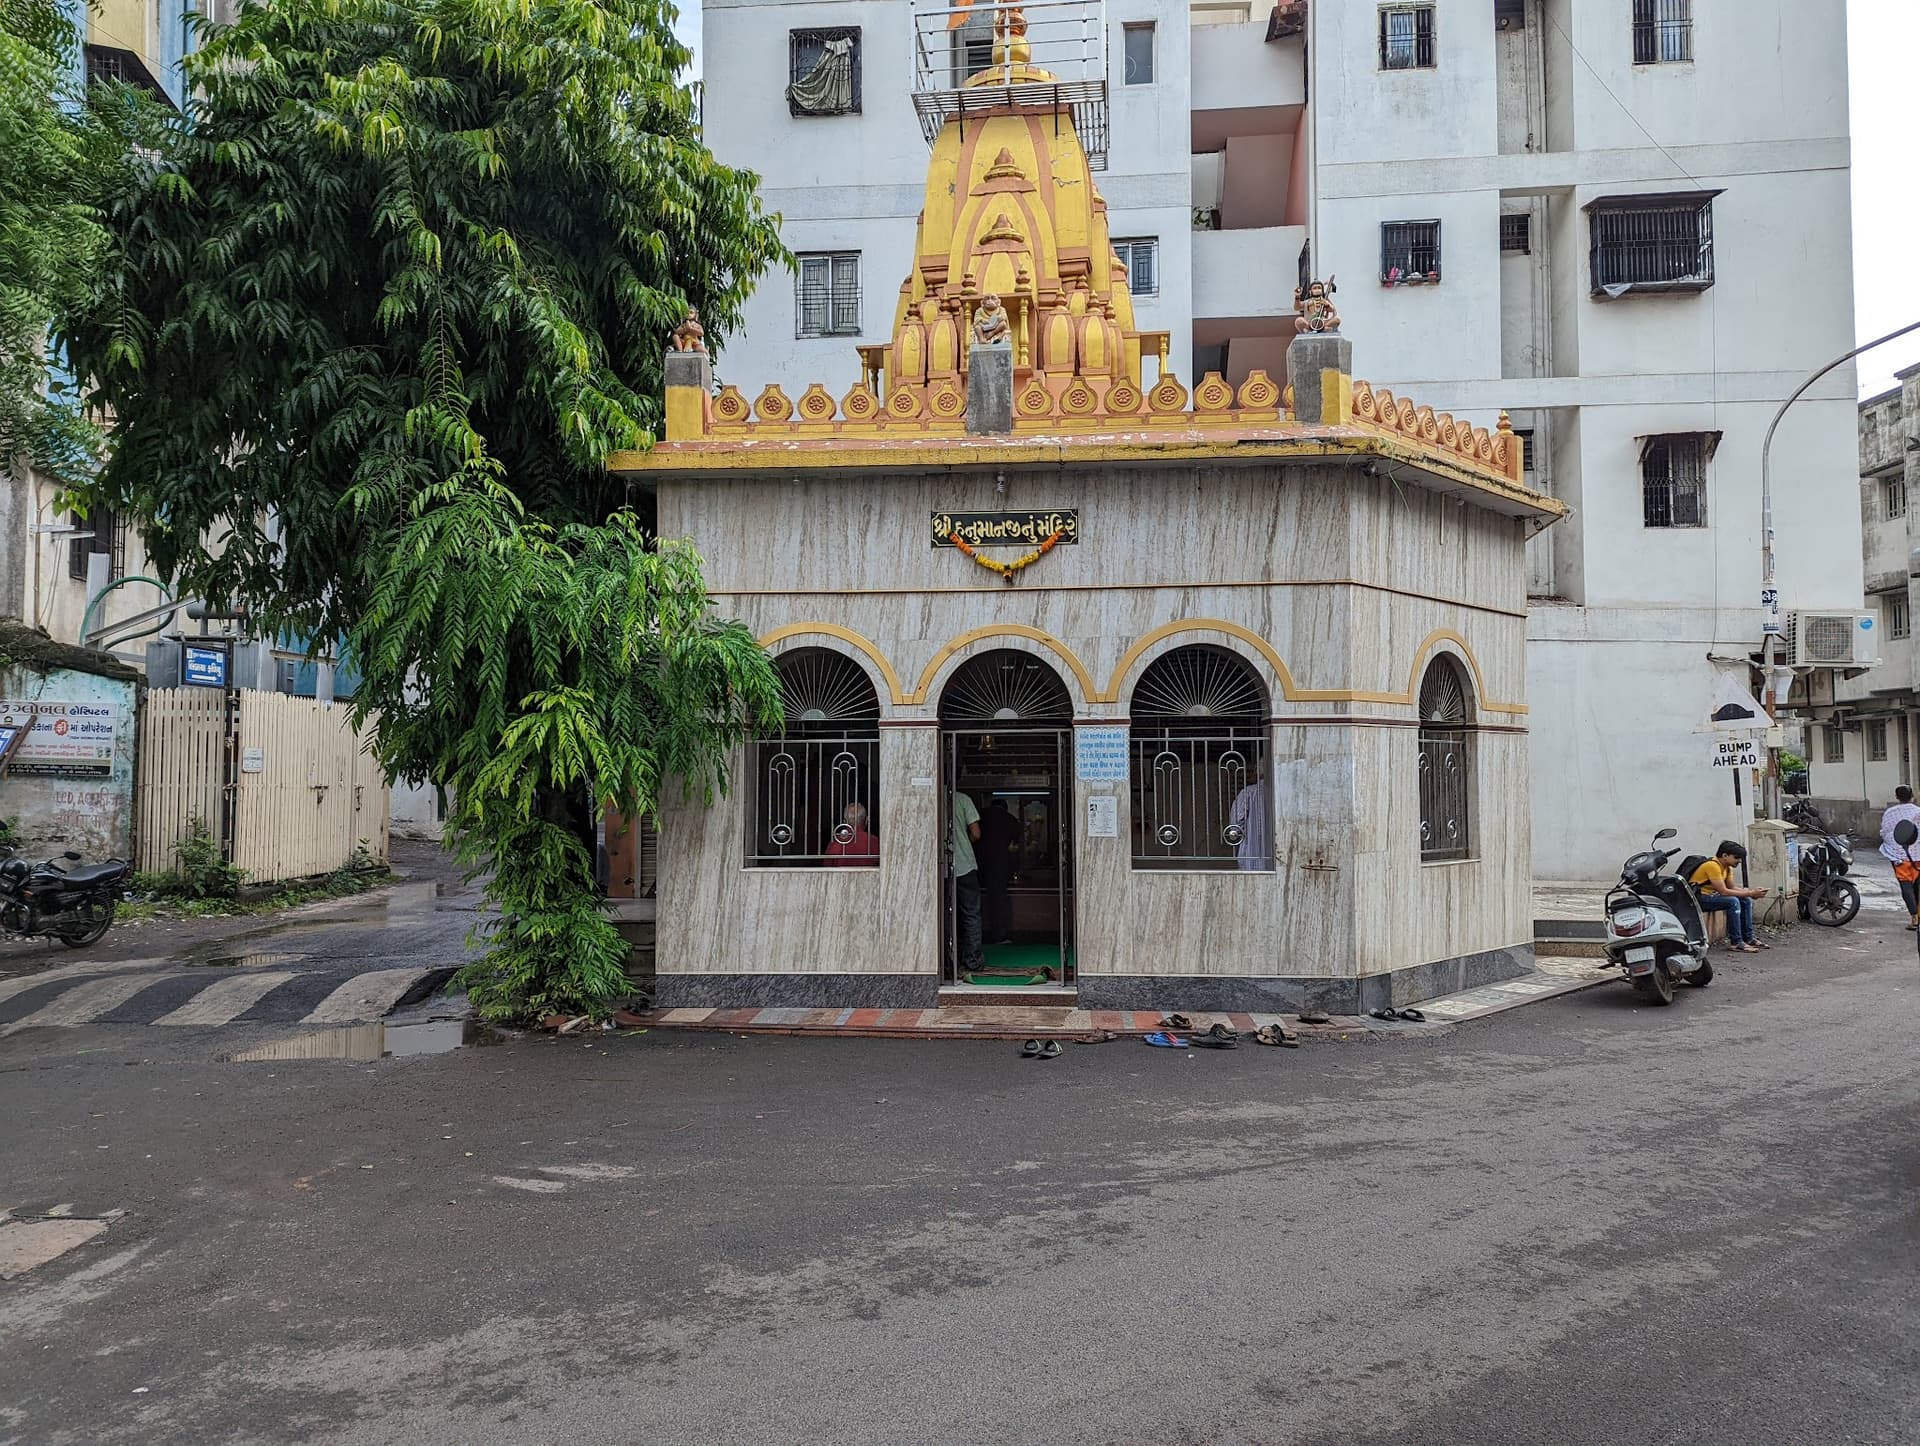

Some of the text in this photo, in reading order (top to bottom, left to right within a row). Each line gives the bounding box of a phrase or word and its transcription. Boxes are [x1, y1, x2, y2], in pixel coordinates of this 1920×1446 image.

[934, 514, 1075, 545] શ્રી હનુમાનજીનું મંદિર
[69, 705, 109, 716] હોસ્પિટલ
[81, 721, 112, 733] ઓપરેશન
[1719, 742, 1752, 753] BUMP
[1713, 754, 1756, 767] AHEAD
